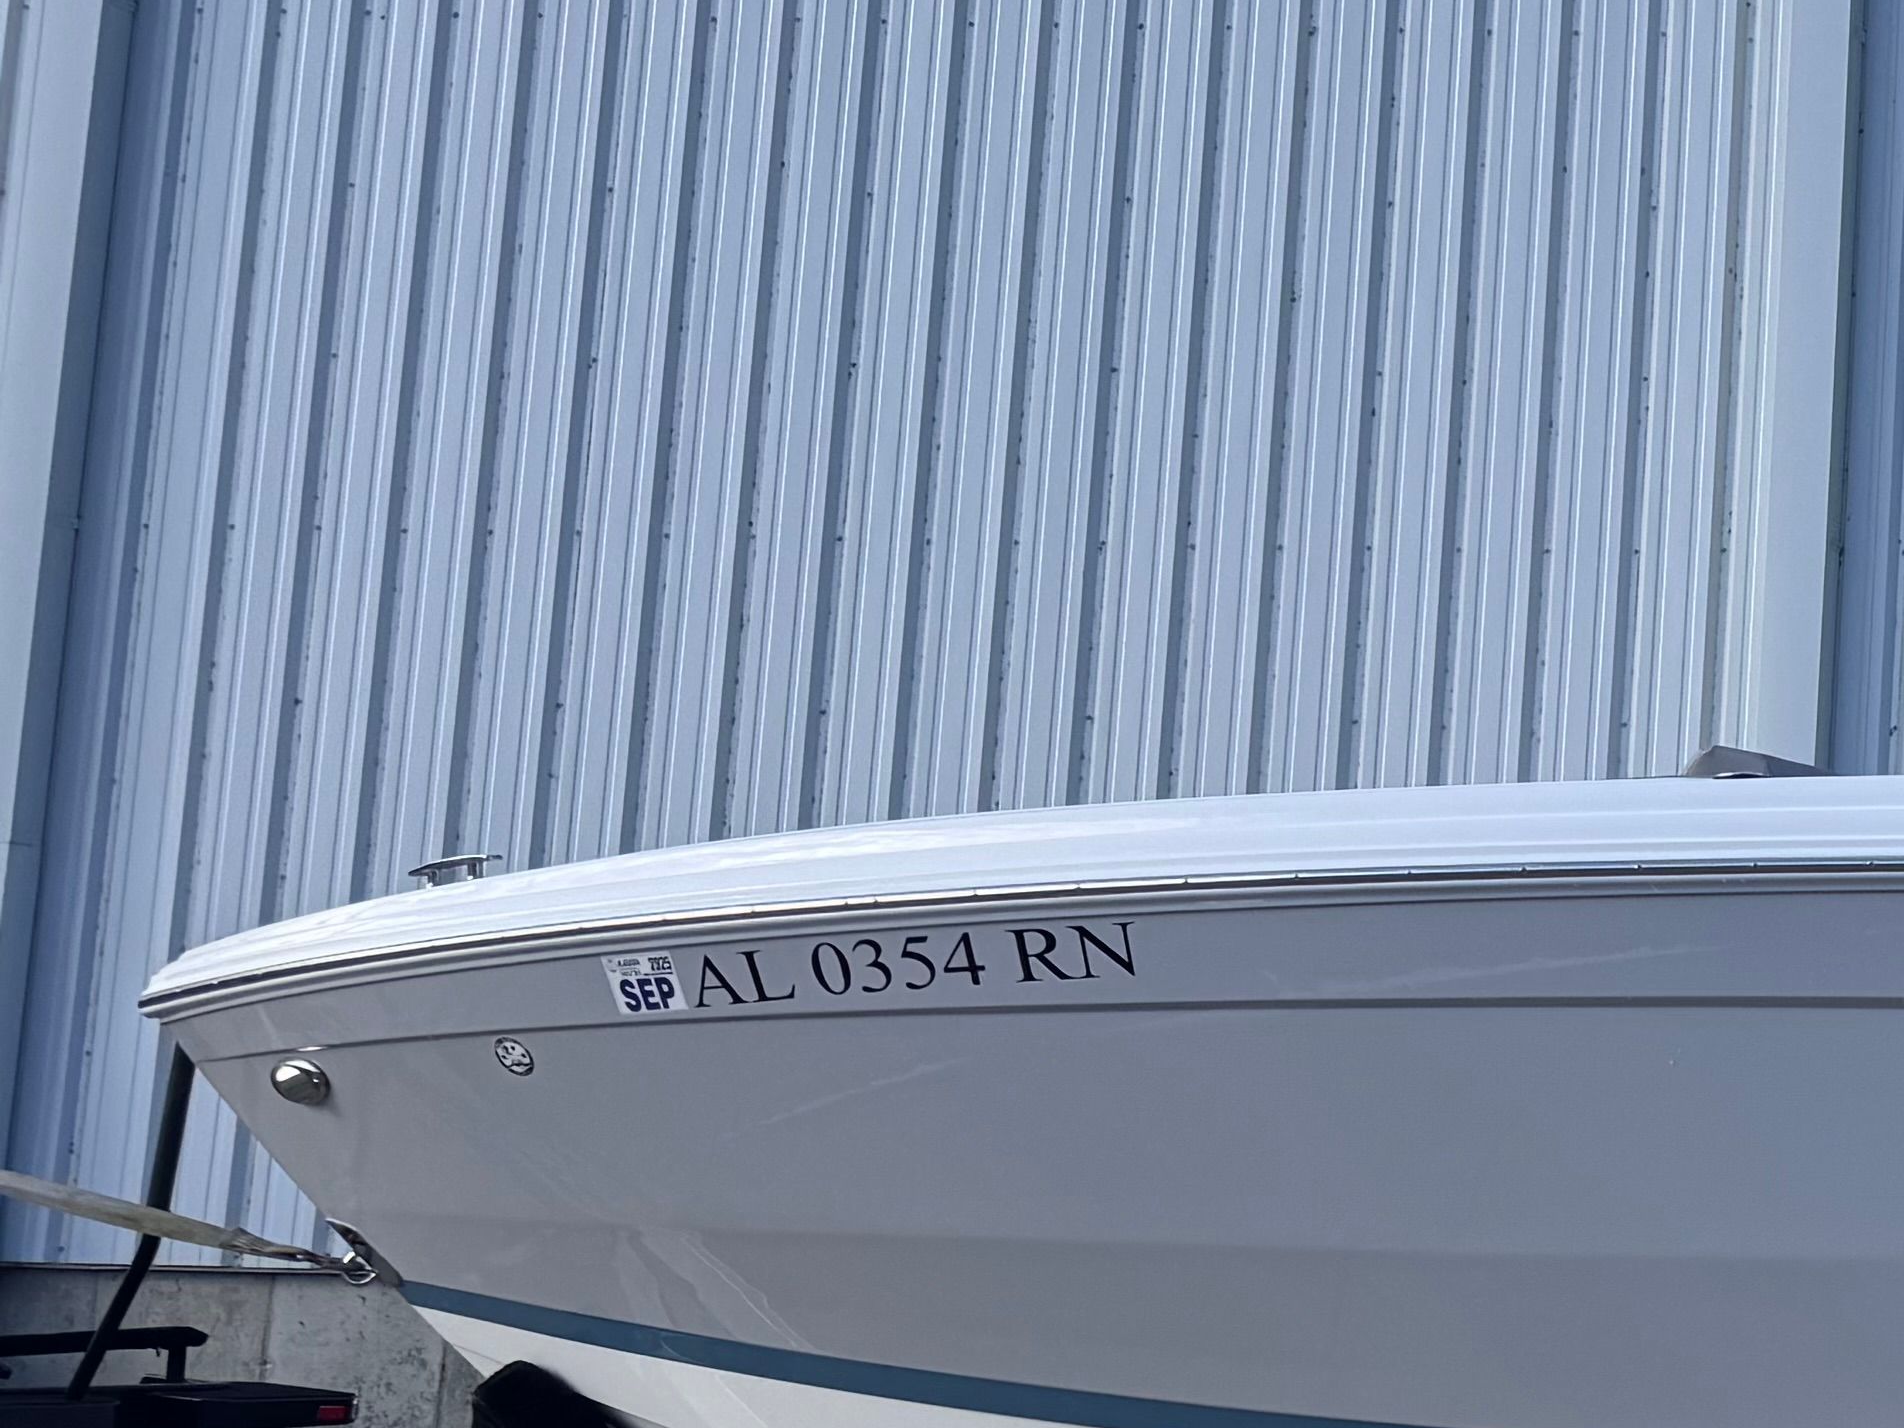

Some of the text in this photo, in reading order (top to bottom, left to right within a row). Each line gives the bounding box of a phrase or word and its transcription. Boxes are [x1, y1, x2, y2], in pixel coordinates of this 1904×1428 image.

[619, 977, 675, 1013] SEP
[694, 921, 1137, 1009] AL 0354 RN
